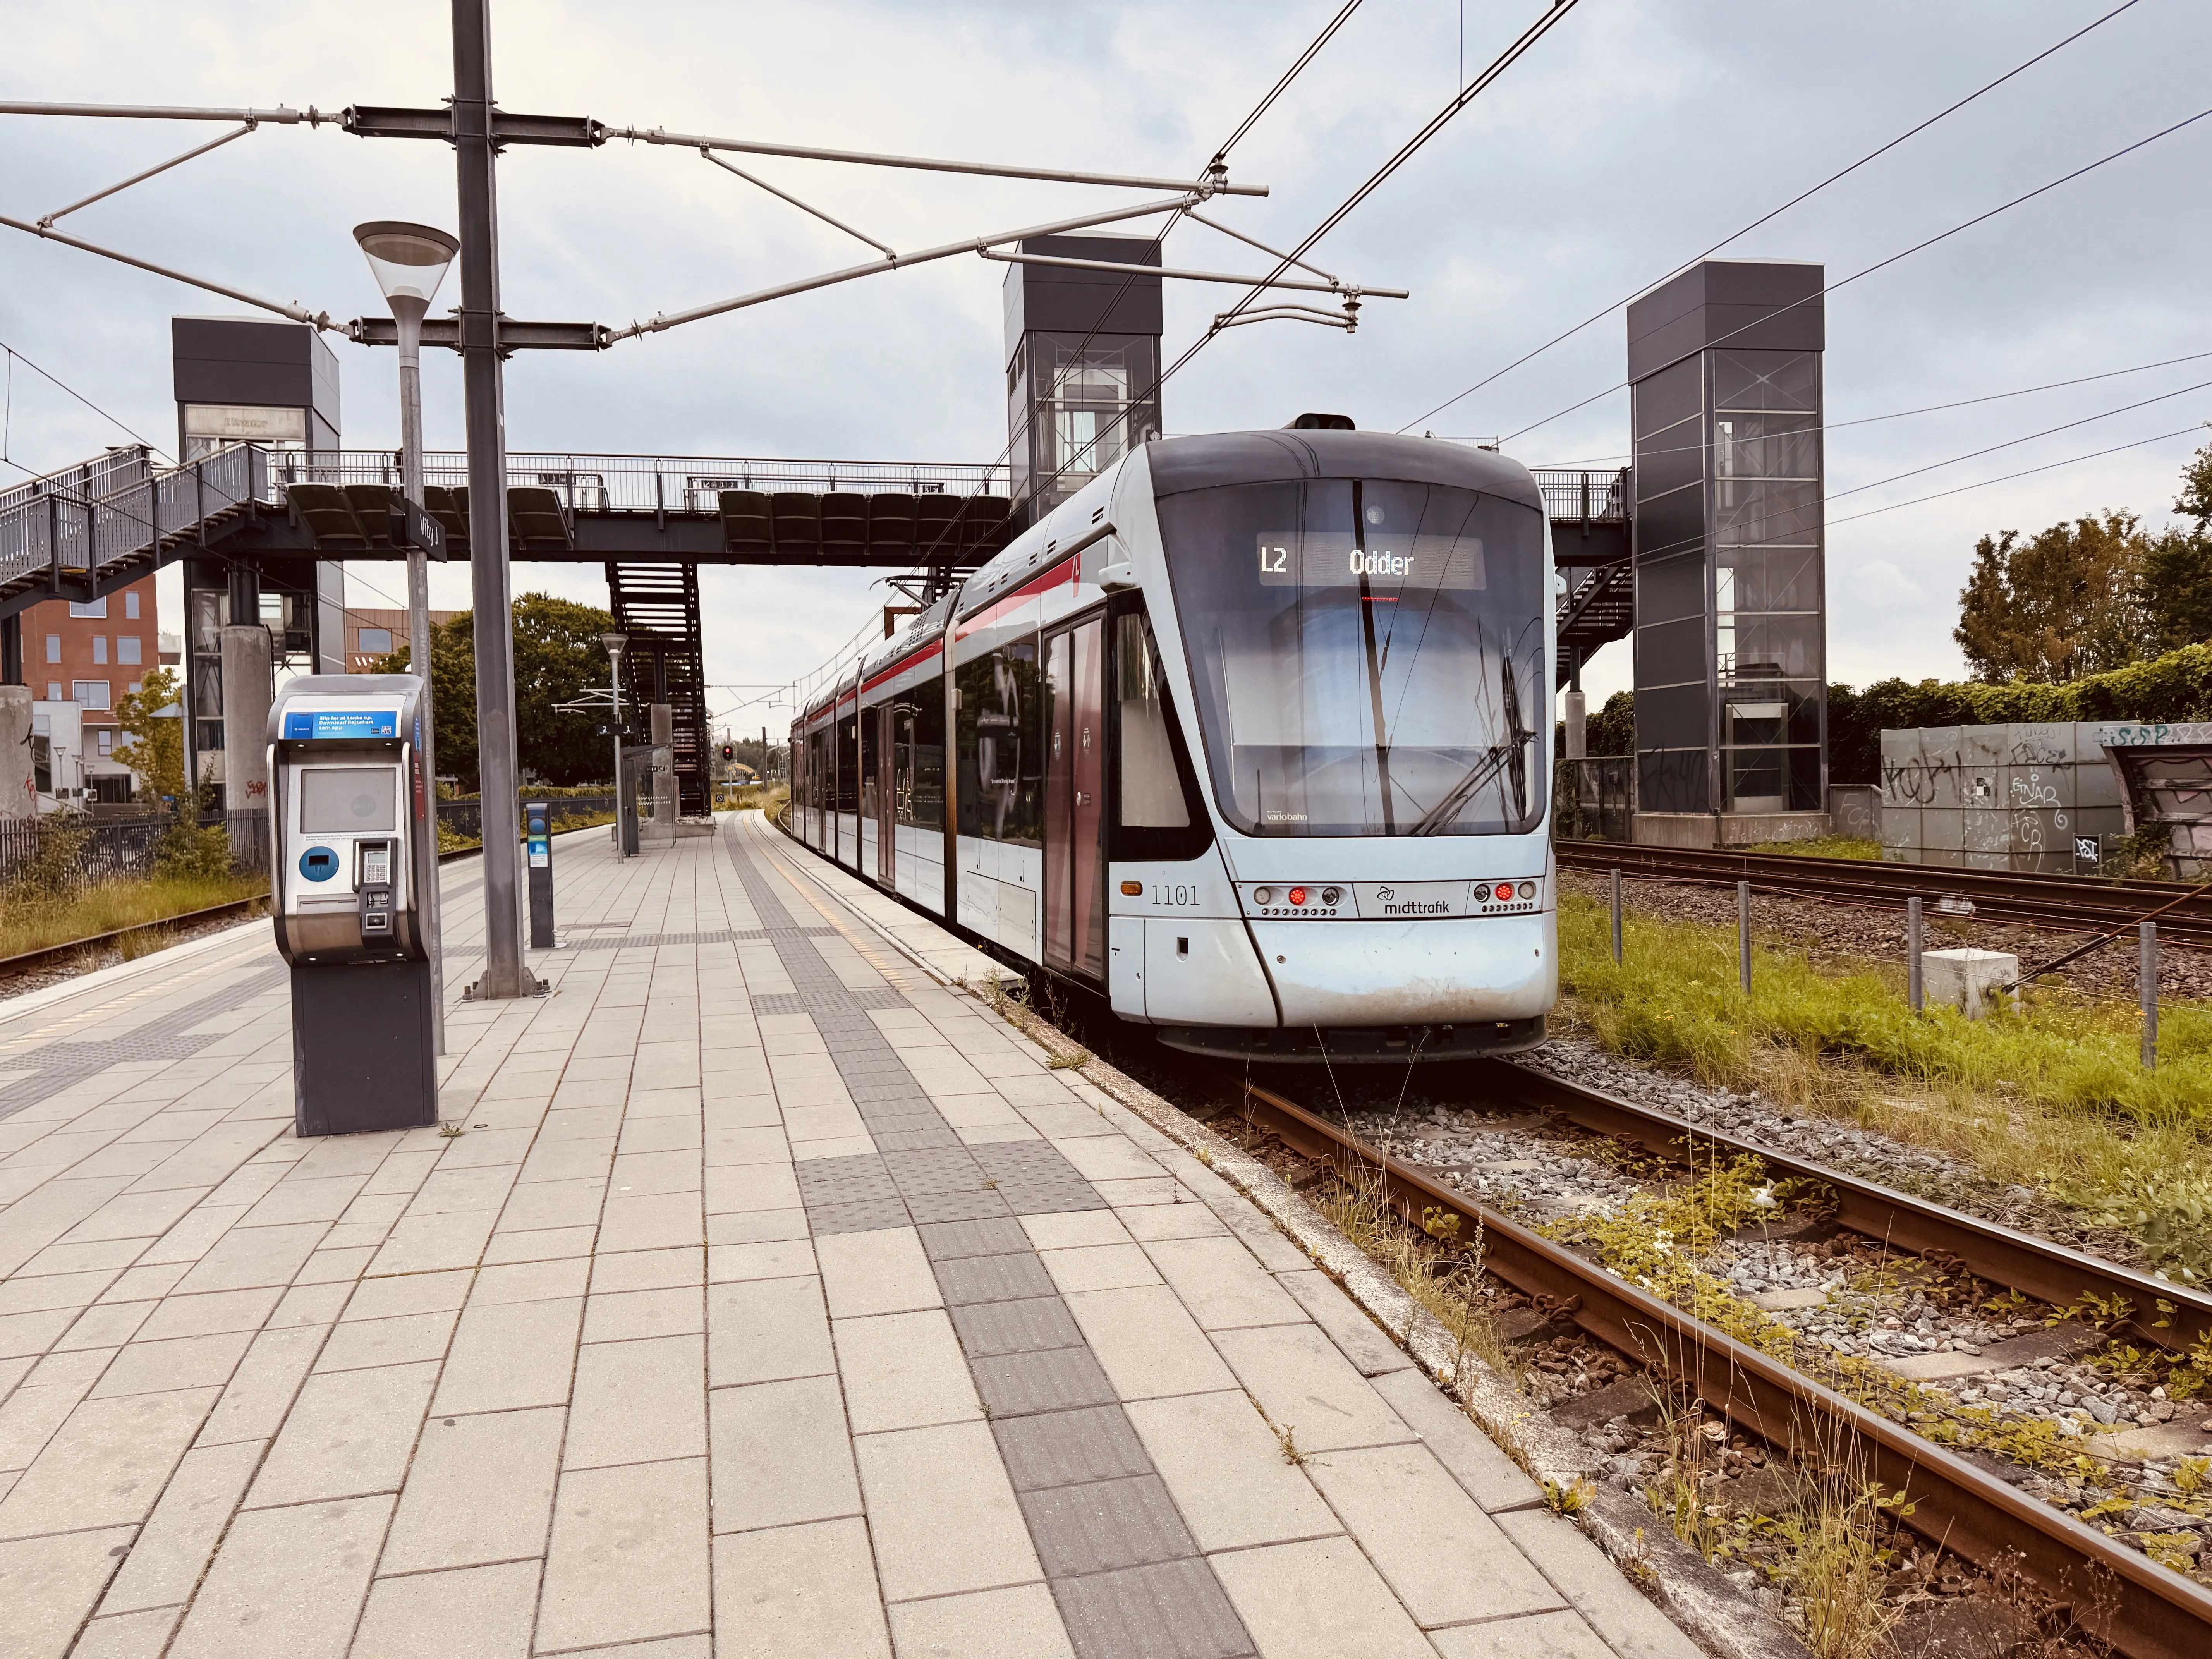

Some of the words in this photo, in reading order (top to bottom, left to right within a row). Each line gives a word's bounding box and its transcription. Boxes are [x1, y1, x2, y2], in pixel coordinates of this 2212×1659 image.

[420, 514, 433, 547] Viby
[435, 527, 438, 545] J
[1261, 547, 1287, 572] L2
[1350, 550, 1414, 575] Odder
[1152, 885, 1200, 905] 1101
[1385, 901, 1449, 914] midttrafik
